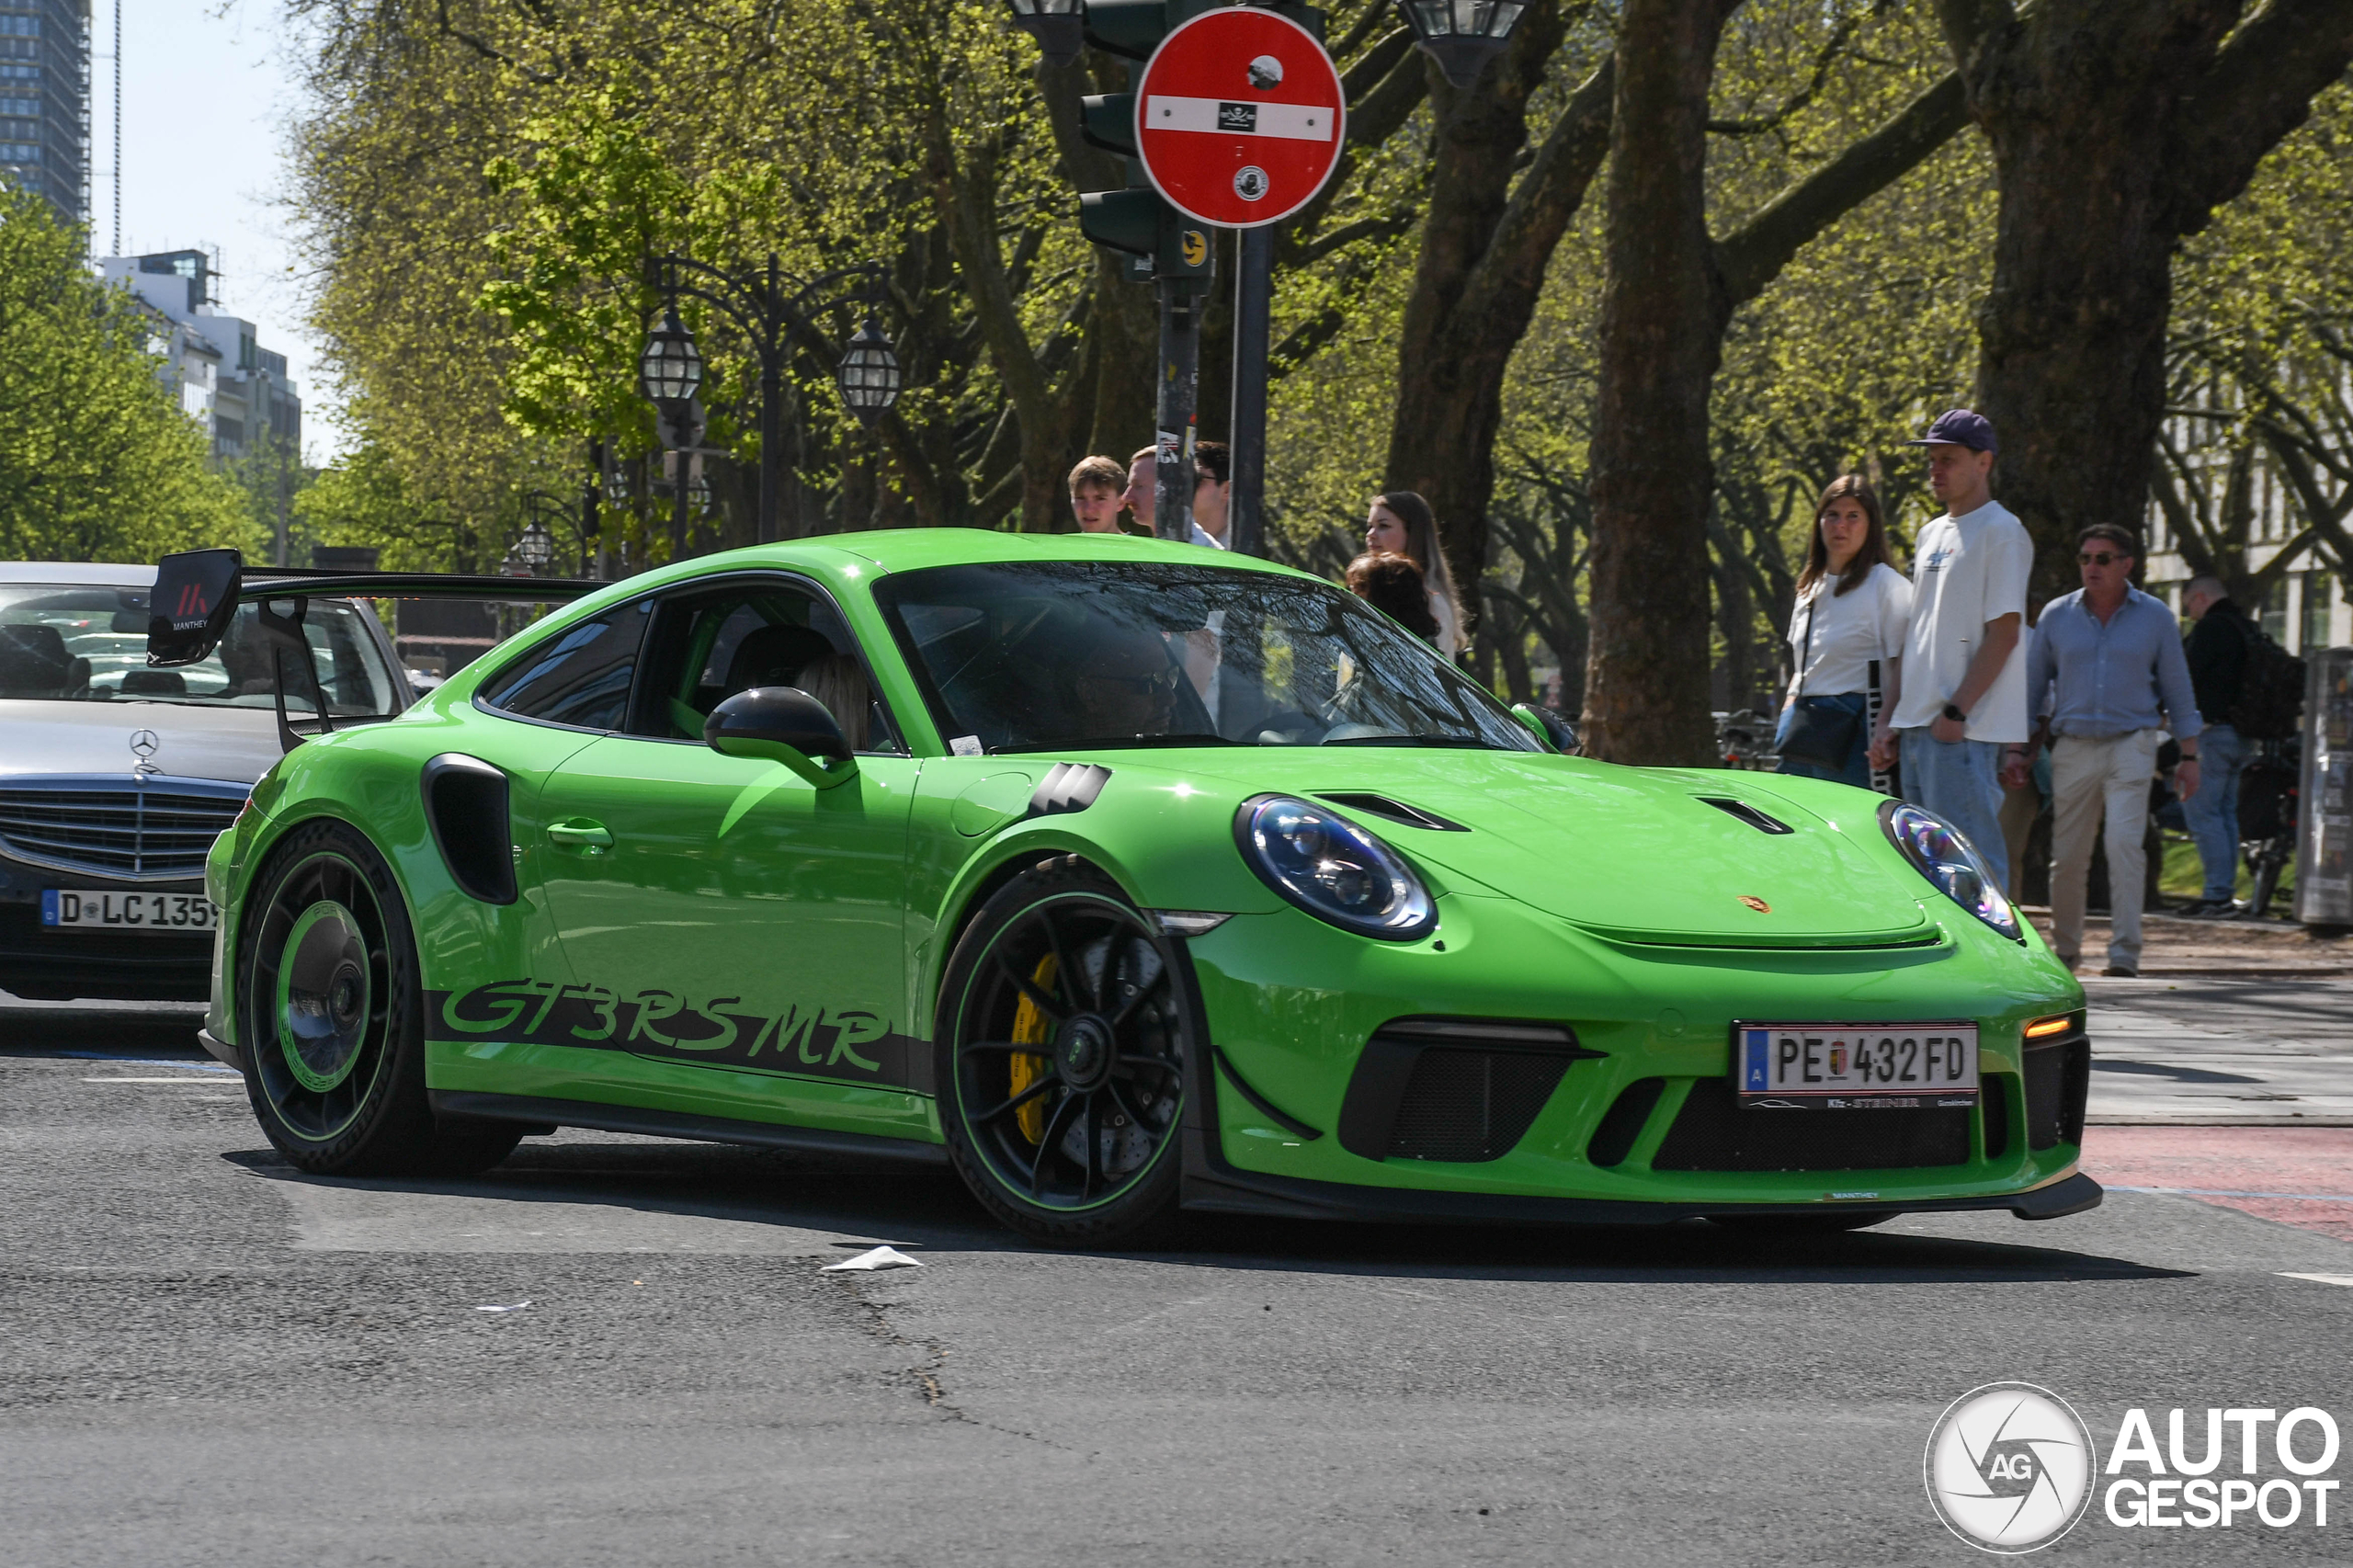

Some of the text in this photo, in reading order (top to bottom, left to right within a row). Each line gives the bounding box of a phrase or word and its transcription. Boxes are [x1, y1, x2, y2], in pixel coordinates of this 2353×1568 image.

[173, 619, 208, 631] MANTHEY
[62, 893, 80, 923] D
[103, 894, 142, 925] LC
[1778, 1038, 1824, 1084] PE
[1751, 1068, 1763, 1082] A
